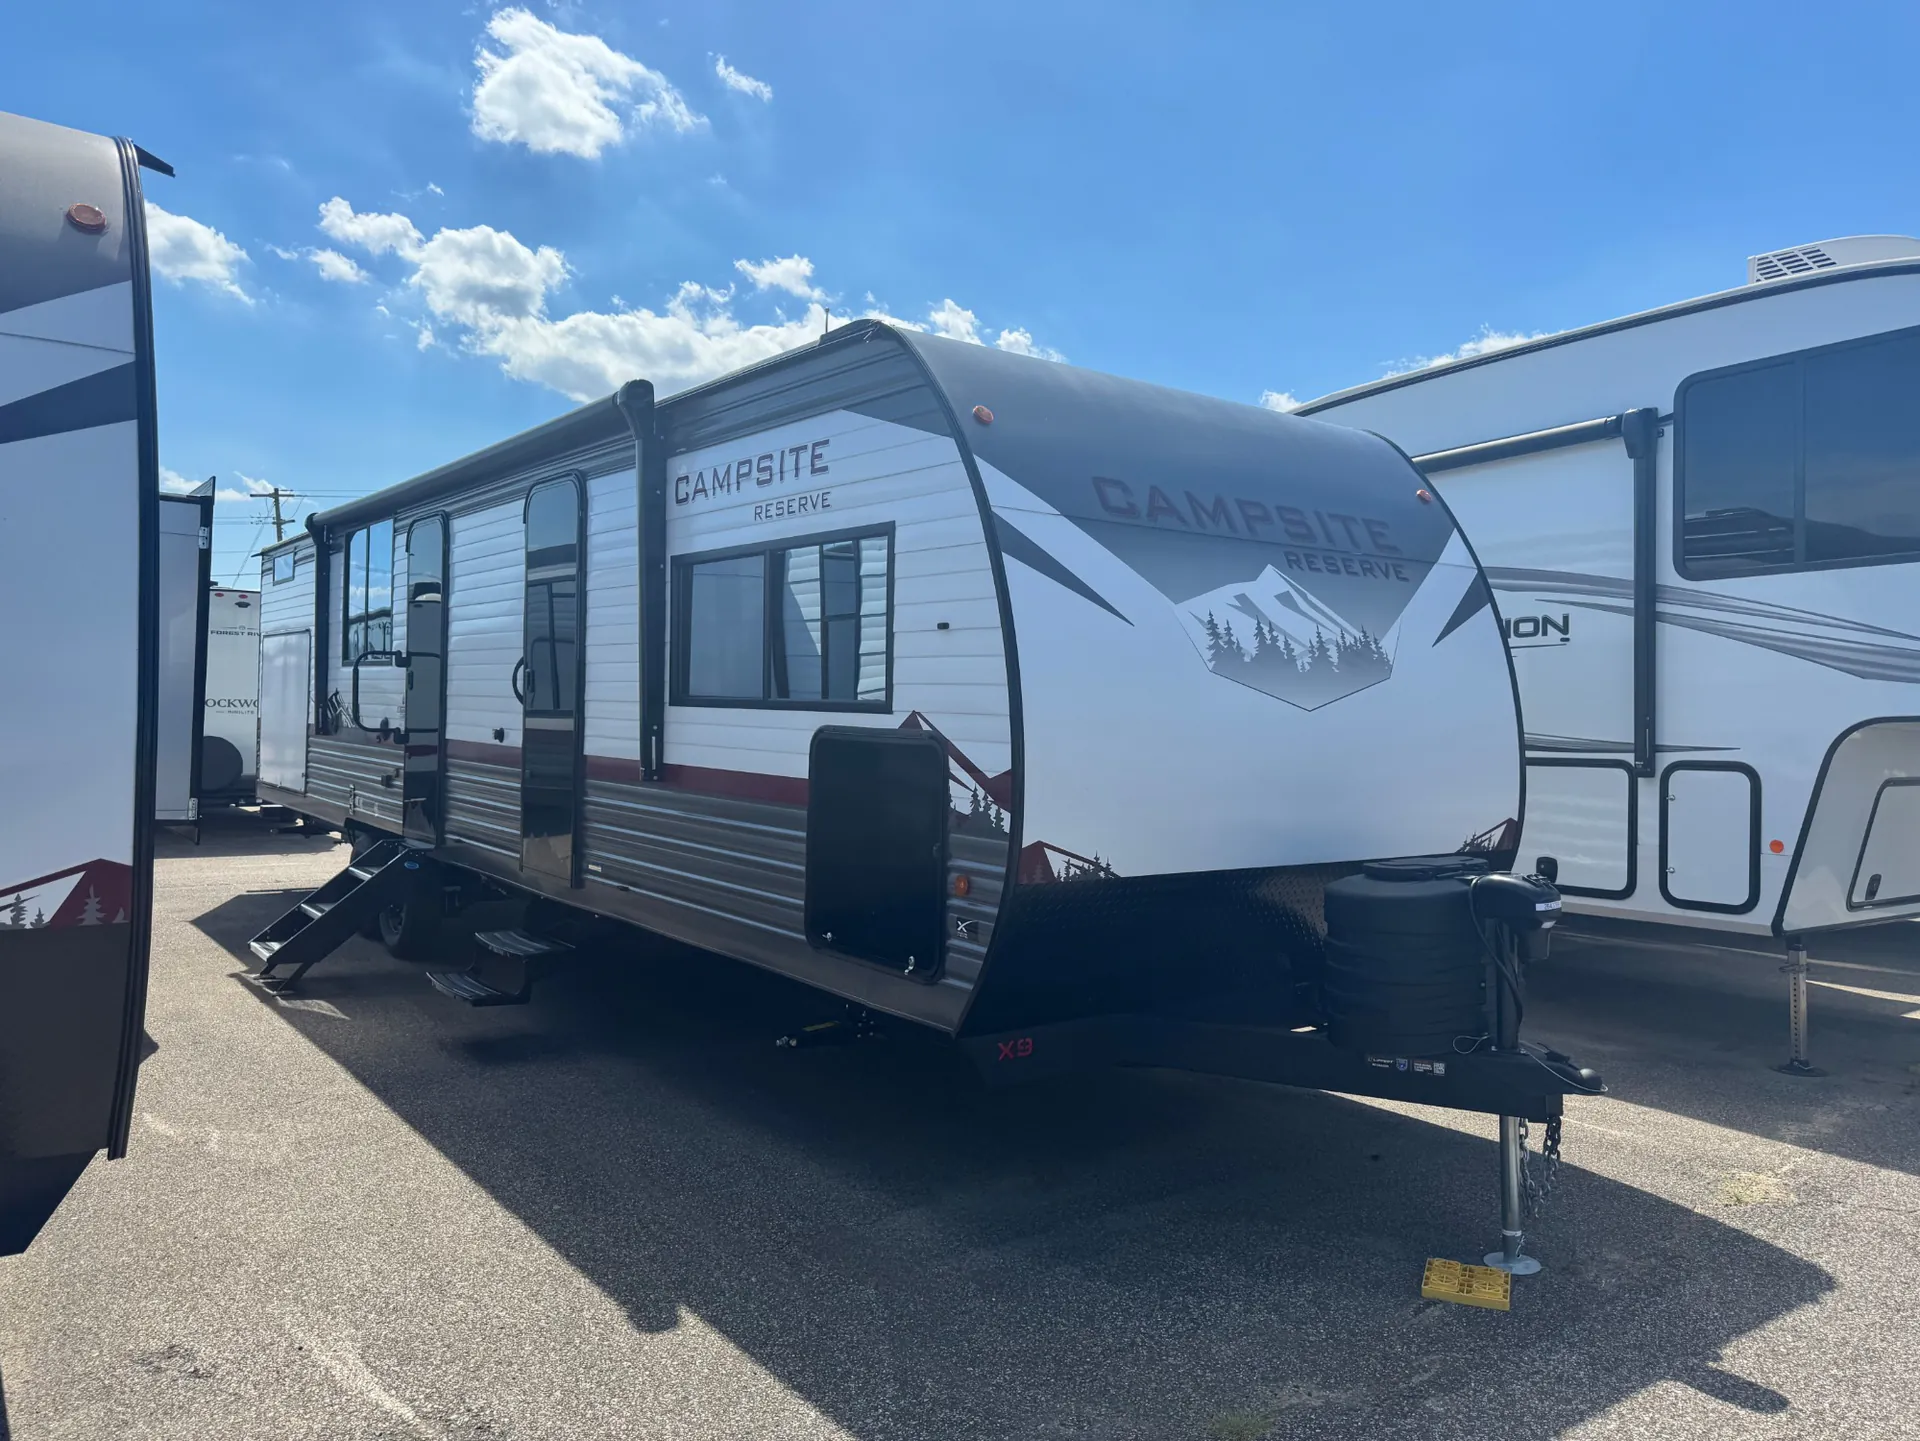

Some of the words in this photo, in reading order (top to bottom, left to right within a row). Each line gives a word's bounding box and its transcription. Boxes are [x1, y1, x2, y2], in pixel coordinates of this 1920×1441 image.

[675, 439, 830, 505] CAMPSITE
[754, 491, 832, 522] RESERVE
[1092, 476, 1403, 554] CAMPSITE
[1284, 551, 1410, 583] RESERVE
